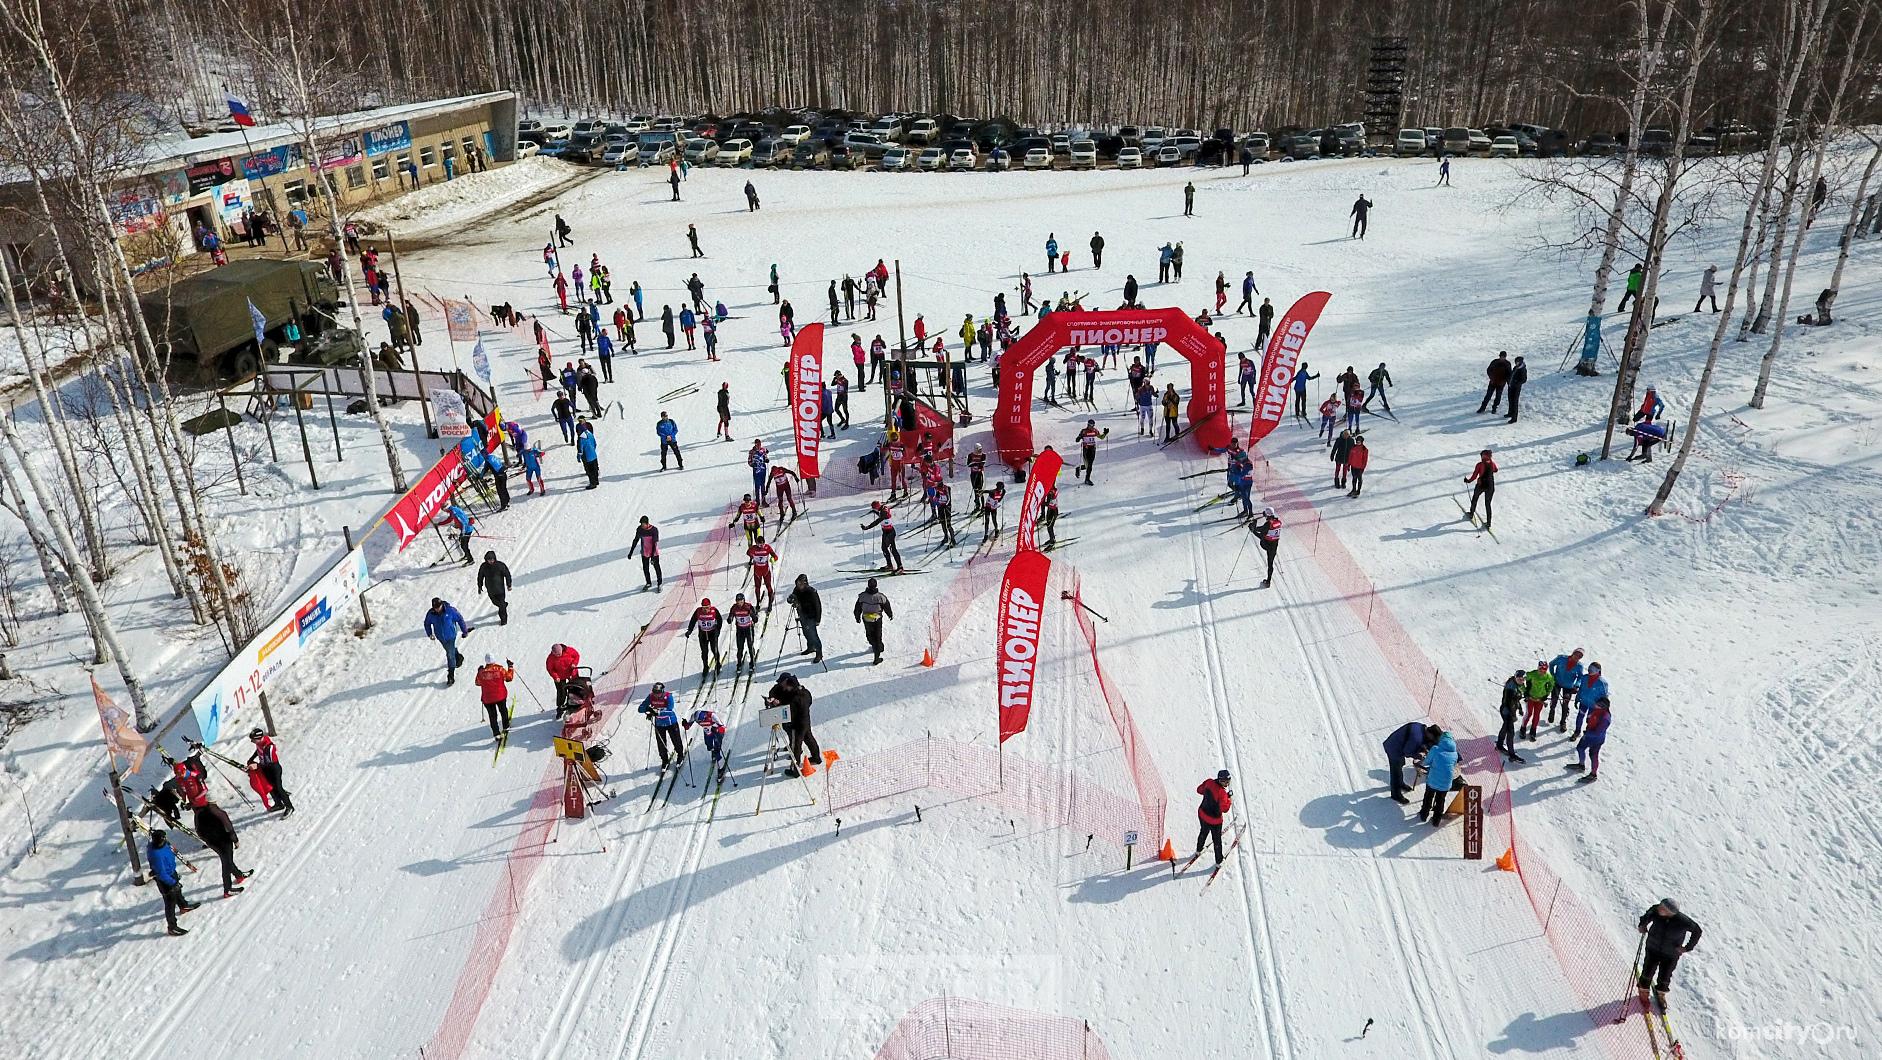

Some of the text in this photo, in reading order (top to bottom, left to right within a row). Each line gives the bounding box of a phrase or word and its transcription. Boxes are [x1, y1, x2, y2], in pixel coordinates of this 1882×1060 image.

[370, 125, 404, 143] ПИОНЕР
[1069, 327, 1168, 345] ПИОНЕР
[1010, 371, 1025, 424] ФИНИШ
[1206, 360, 1218, 413] ФИНИШ
[1260, 320, 1307, 422] ПИОНЕР
[799, 354, 820, 457] ПИОНЕР
[417, 462, 465, 524] ATOMIC
[1001, 587, 1040, 708] ПИОНЕР
[233, 669, 263, 709] 11-12
[1126, 834, 1137, 842] 20
[1468, 788, 1479, 854] ФИНИШ
